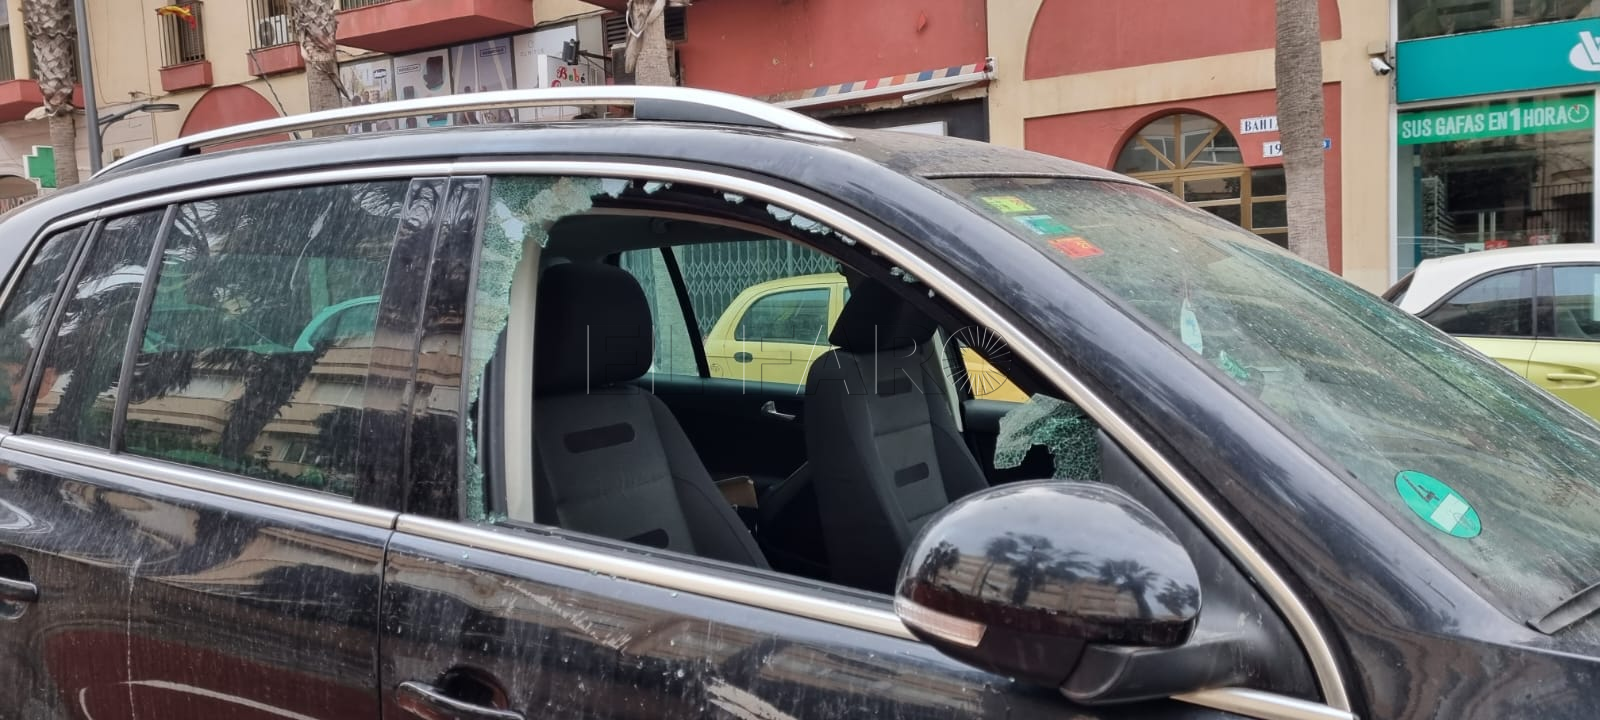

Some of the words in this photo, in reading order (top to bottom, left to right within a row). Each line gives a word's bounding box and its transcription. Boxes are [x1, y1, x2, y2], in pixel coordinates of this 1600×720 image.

[1244, 119, 1279, 132] BAHI
[1402, 119, 1432, 139] SUS
[1435, 114, 1484, 136] GAFAS
[1488, 111, 1508, 131] EN
[1510, 108, 1521, 131] 1
[1523, 106, 1568, 128] HORA
